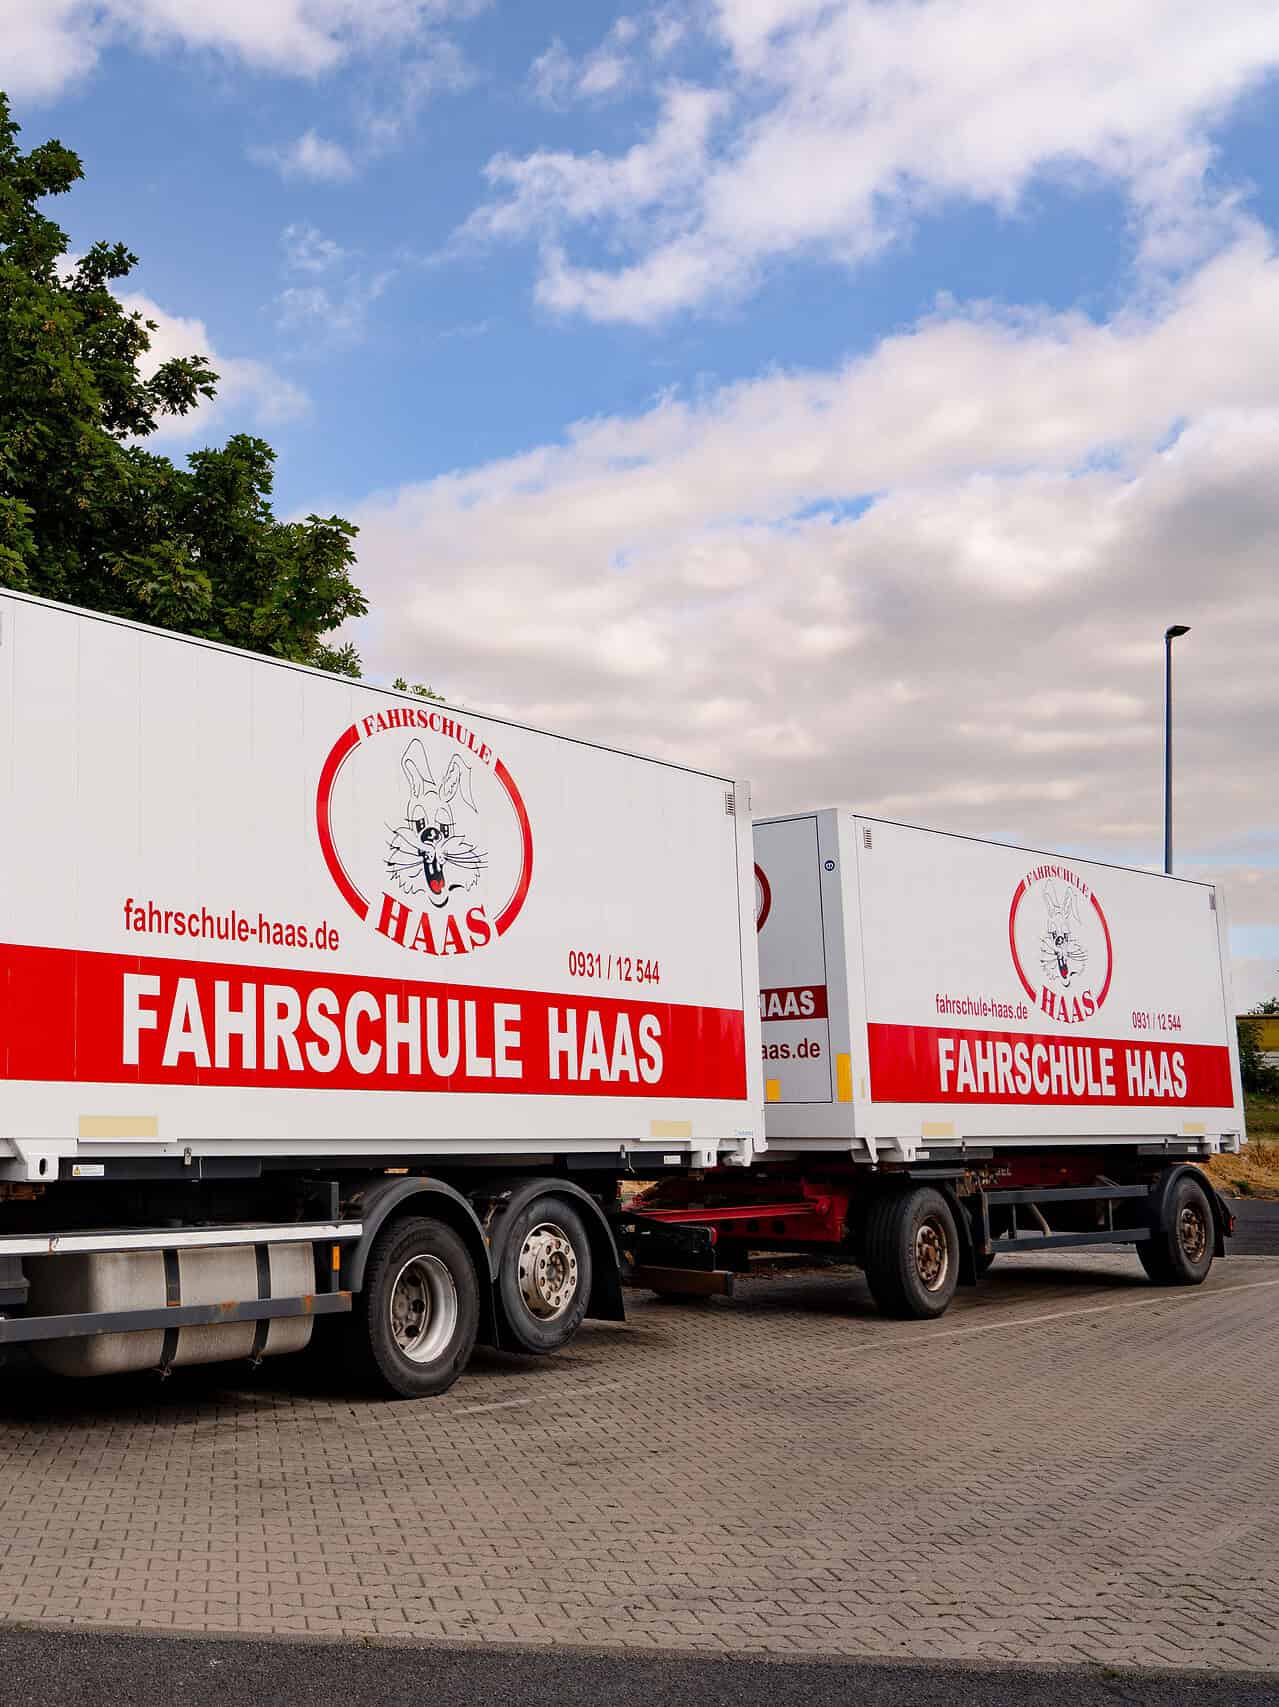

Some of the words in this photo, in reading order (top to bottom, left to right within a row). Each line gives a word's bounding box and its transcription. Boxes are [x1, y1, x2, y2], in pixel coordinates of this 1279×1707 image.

[361, 707, 493, 766] FAHRSCHULE
[1026, 865, 1089, 899] FAHRSCHULE
[123, 898, 340, 952] fahrschule-haas.de
[374, 891, 492, 957] HAAS
[568, 949, 602, 979] 0931
[616, 956, 633, 982] 12
[636, 958, 661, 985] 544
[935, 993, 1028, 1020] fahrschule-haas.de
[1040, 985, 1095, 1024] HAAS
[1132, 1011, 1150, 1029] 0931
[1167, 1014, 1181, 1031] 544
[122, 973, 523, 1080] FAHRSCHULE
[549, 1007, 663, 1084] HAAS
[937, 1038, 1116, 1097] FAHRSCHULE
[1126, 1049, 1187, 1098] HAAS
